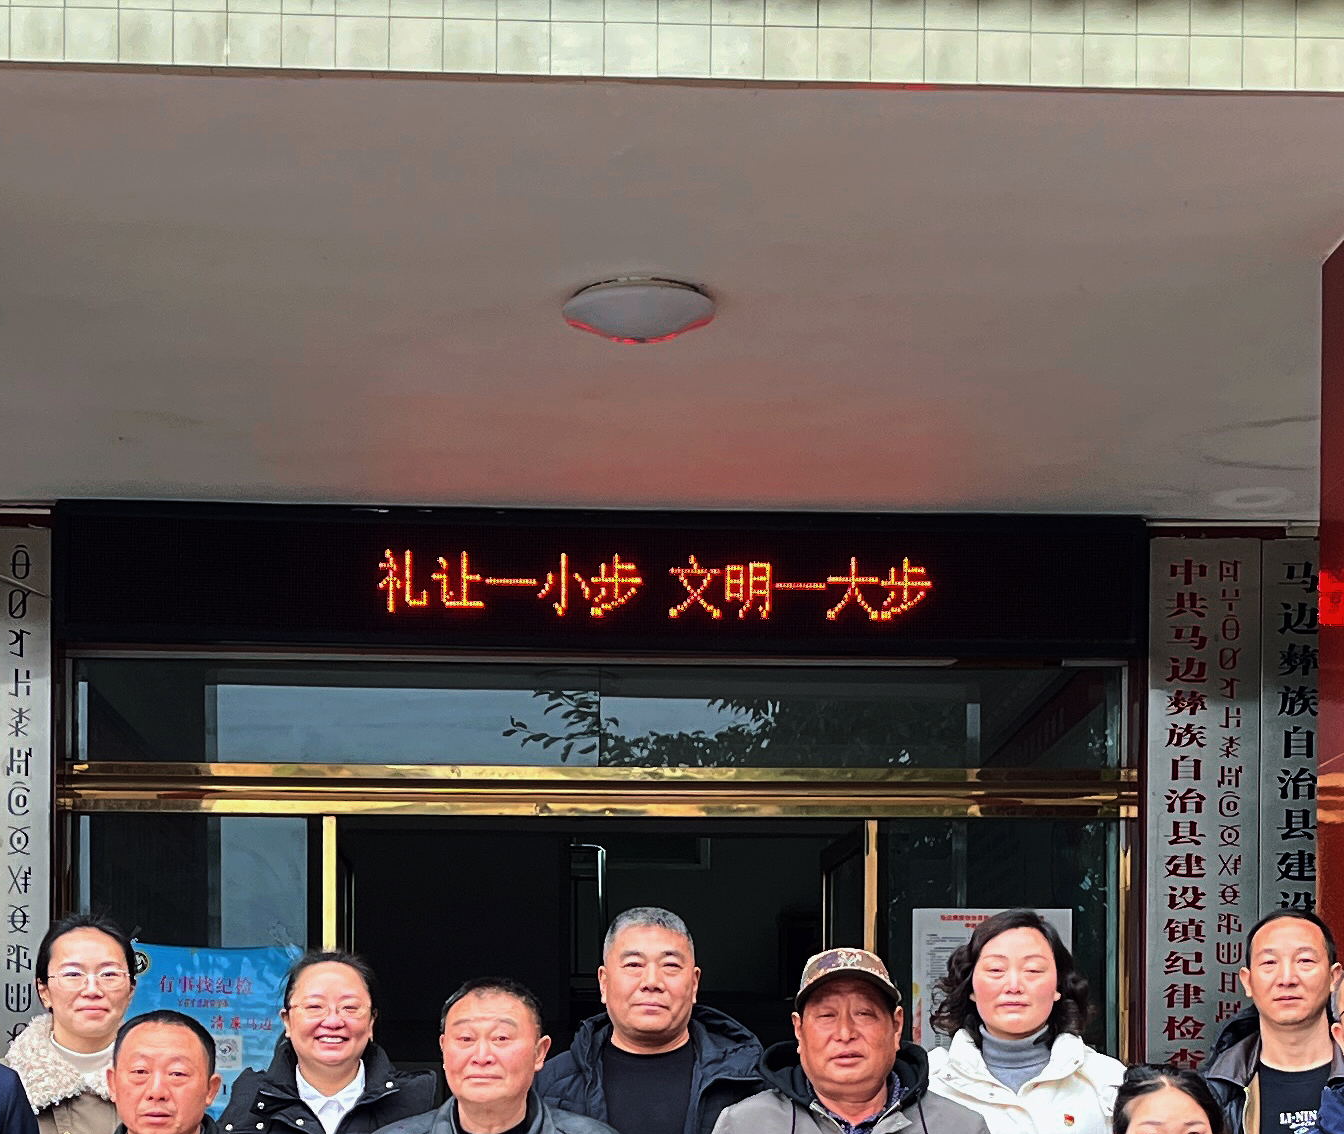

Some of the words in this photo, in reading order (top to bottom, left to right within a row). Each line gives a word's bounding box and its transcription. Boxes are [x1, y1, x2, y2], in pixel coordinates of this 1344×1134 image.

[378, 549, 643, 618] 礼让一小步
[668, 554, 933, 619] 文明一大步
[1163, 559, 1208, 1070] 中共马边彝族自治县建设镇纪律检查
[1280, 1110, 1317, 1125] LI-NIN
